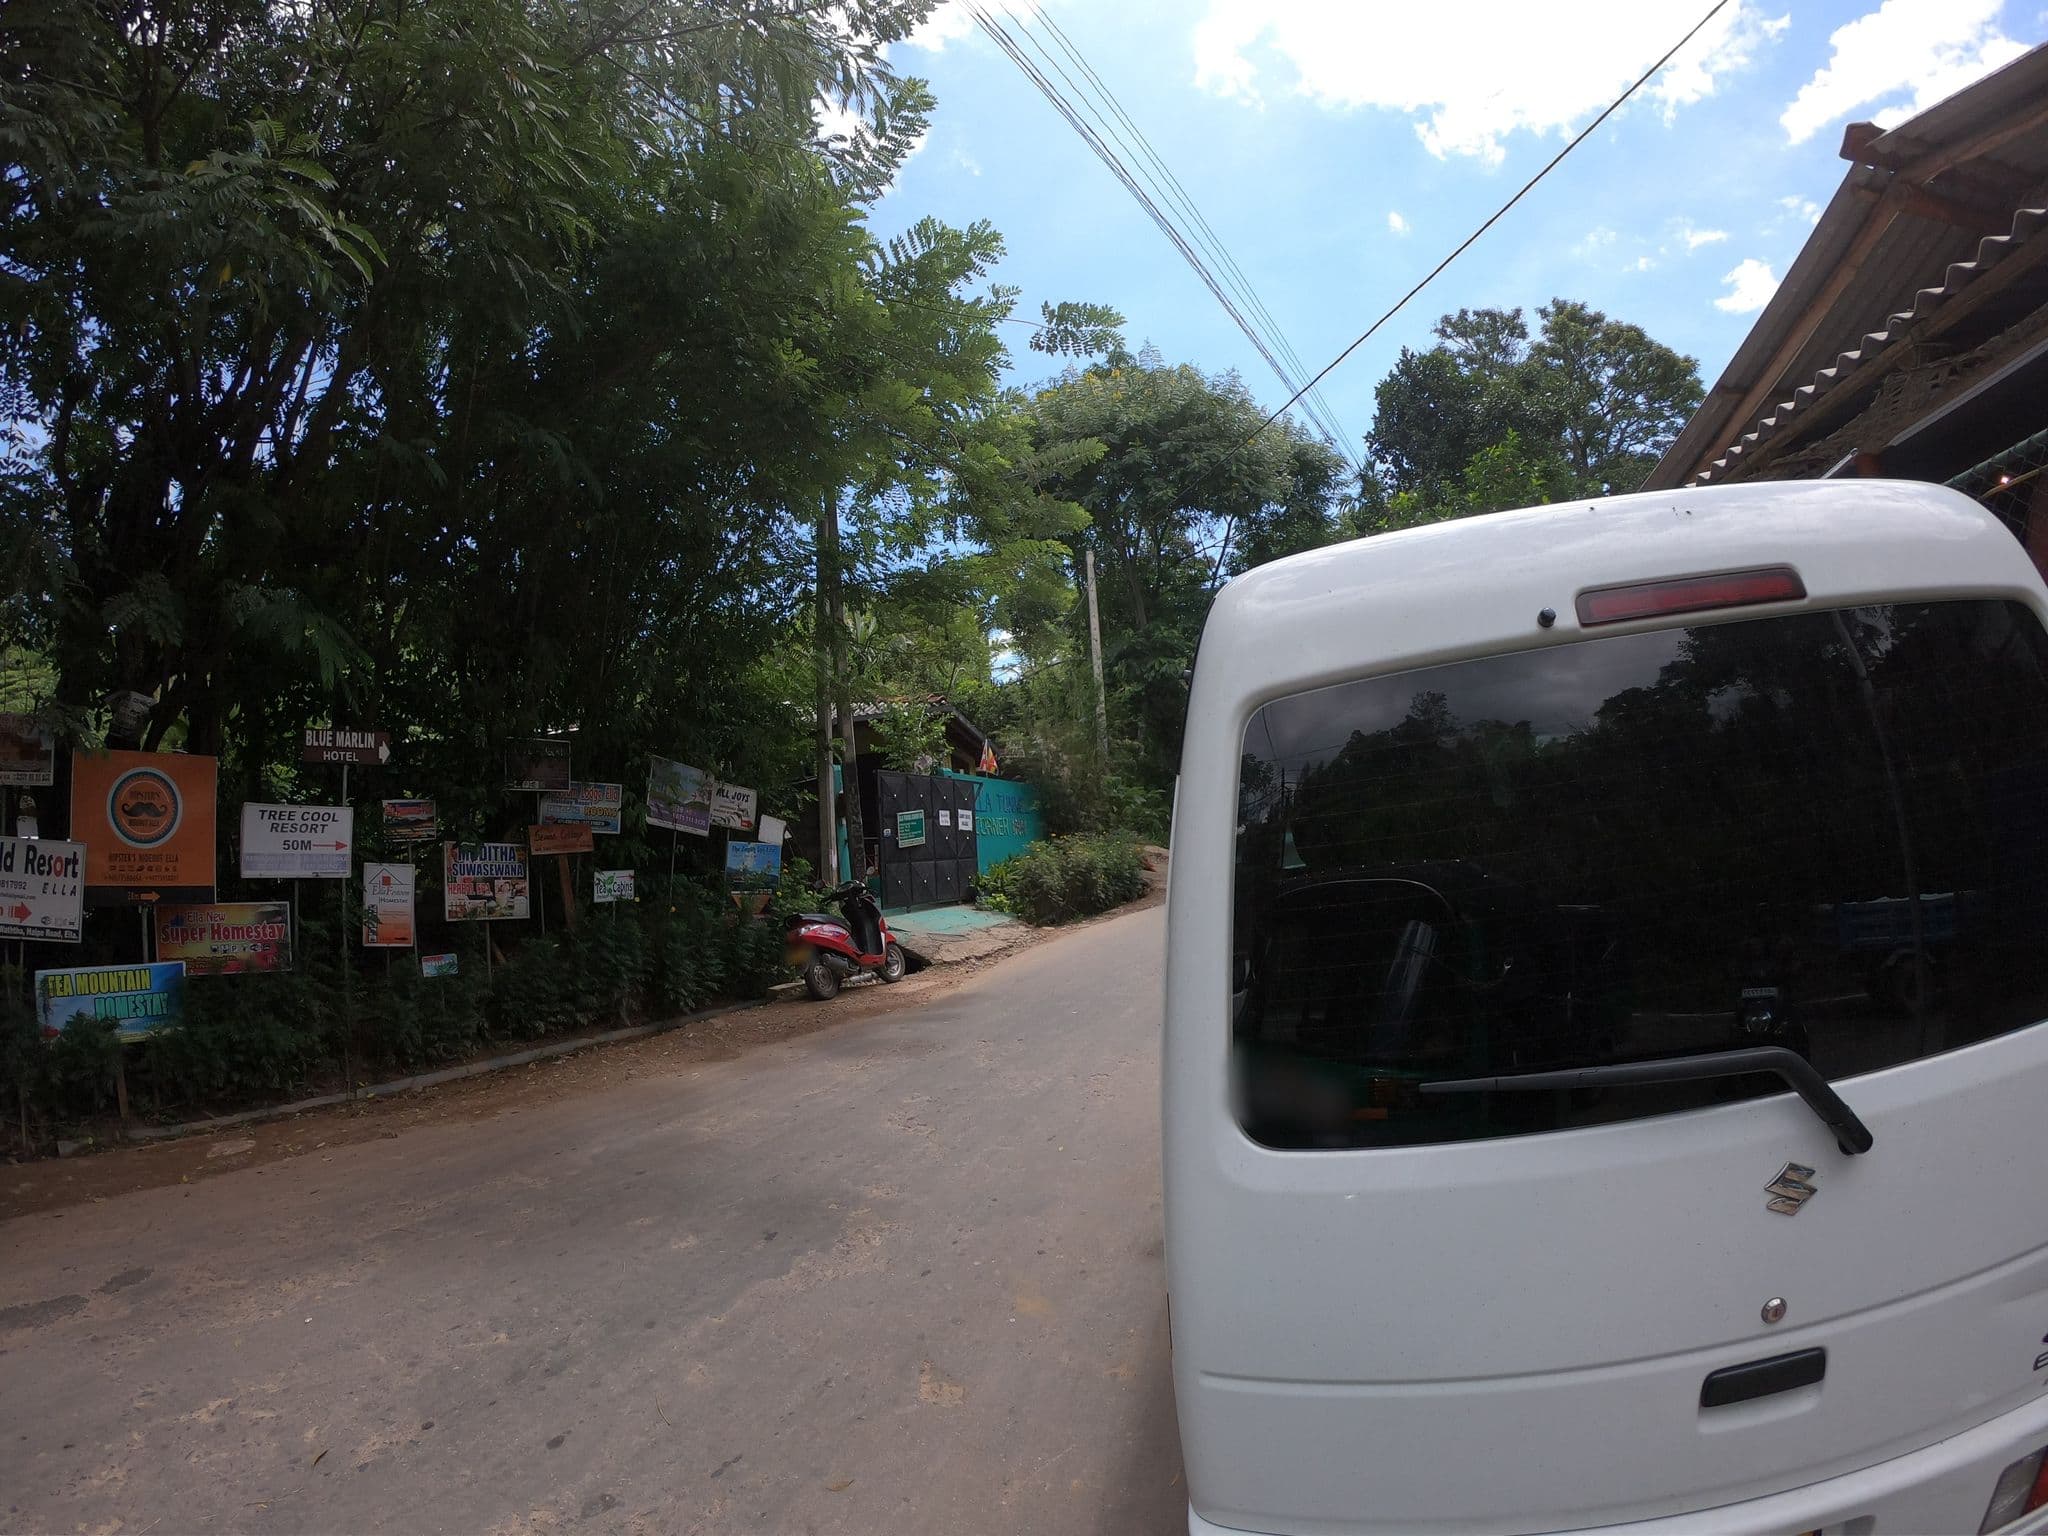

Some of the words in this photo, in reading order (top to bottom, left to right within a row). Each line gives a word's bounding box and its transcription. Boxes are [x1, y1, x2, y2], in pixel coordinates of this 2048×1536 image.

[305, 730, 333, 746] BLUE
[336, 731, 375, 748] MARLIN
[323, 751, 360, 762] HOTEL
[716, 787, 729, 800] ALL
[731, 791, 750, 804] JOYS
[259, 810, 296, 822] TREE
[301, 812, 339, 823] COOL
[270, 823, 329, 835] RESORT
[282, 840, 312, 852] 50M
[24, 844, 79, 879] Resort
[458, 846, 516, 862] MDITHA
[452, 863, 524, 877] SUWASEWANA
[42, 882, 77, 897] ELLA
[187, 912, 203, 922] Ella
[206, 912, 225, 922] New
[160, 925, 206, 943] Super
[210, 923, 285, 943] Homestay
[47, 974, 73, 998] TEA
[75, 969, 152, 995] MOUNTAIN
[94, 993, 169, 1021] HOMESTAY
